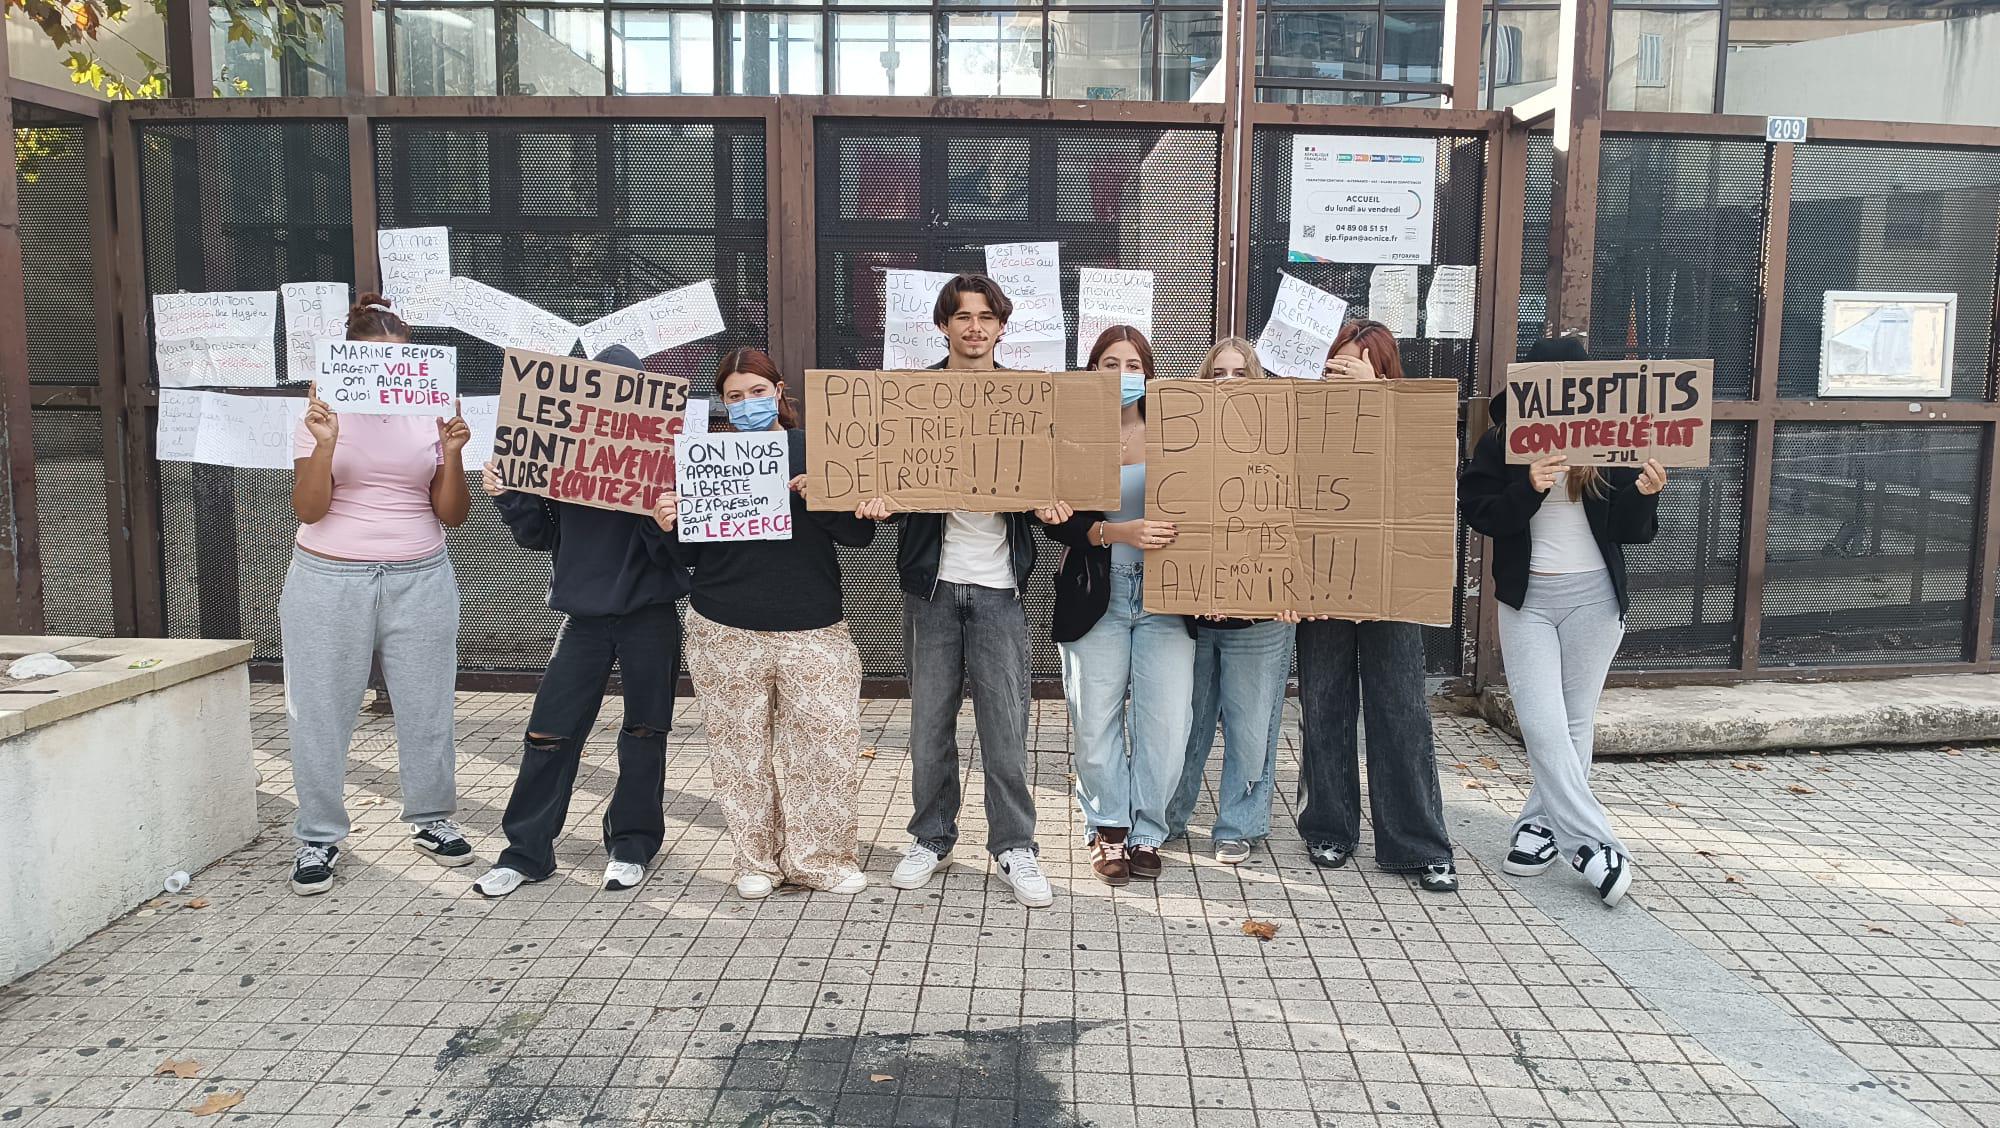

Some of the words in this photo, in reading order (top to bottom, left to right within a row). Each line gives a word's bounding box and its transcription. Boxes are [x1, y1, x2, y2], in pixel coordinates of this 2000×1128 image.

[1774, 120, 1800, 139] 209
[1346, 195, 1380, 203] ACCUEIL
[1324, 234, 1398, 242] gip.fipan@ac-nice.fr
[1020, 244, 1040, 255] PAS
[889, 273, 915, 290] JE
[1280, 276, 1317, 300] LEVER
[891, 292, 931, 314] PLUS
[1276, 299, 1334, 339] RENTRÉE
[889, 333, 918, 347] QUE
[1260, 338, 1288, 359] PAS
[402, 346, 445, 358] RENDS
[1000, 342, 1031, 361] PAS
[322, 362, 379, 374] L'ARGENT
[384, 359, 430, 376] VOLÉ
[509, 355, 602, 399] VOUS
[376, 375, 412, 387] AURA
[419, 379, 438, 389] DE
[825, 374, 1052, 418] PARCOURSUP
[517, 393, 572, 429] LES
[1158, 387, 1380, 458] BOUFFE
[825, 419, 899, 448] NOUS
[494, 426, 576, 467] SONT
[688, 440, 726, 463] ON
[903, 446, 956, 465] NOUS
[495, 457, 548, 489] ALORS
[686, 462, 755, 480] APPREND
[760, 461, 778, 475] LA
[1247, 463, 1271, 475] MES
[683, 525, 699, 536] on
[1226, 516, 1289, 551] PAS
[1230, 562, 1263, 577] MON
